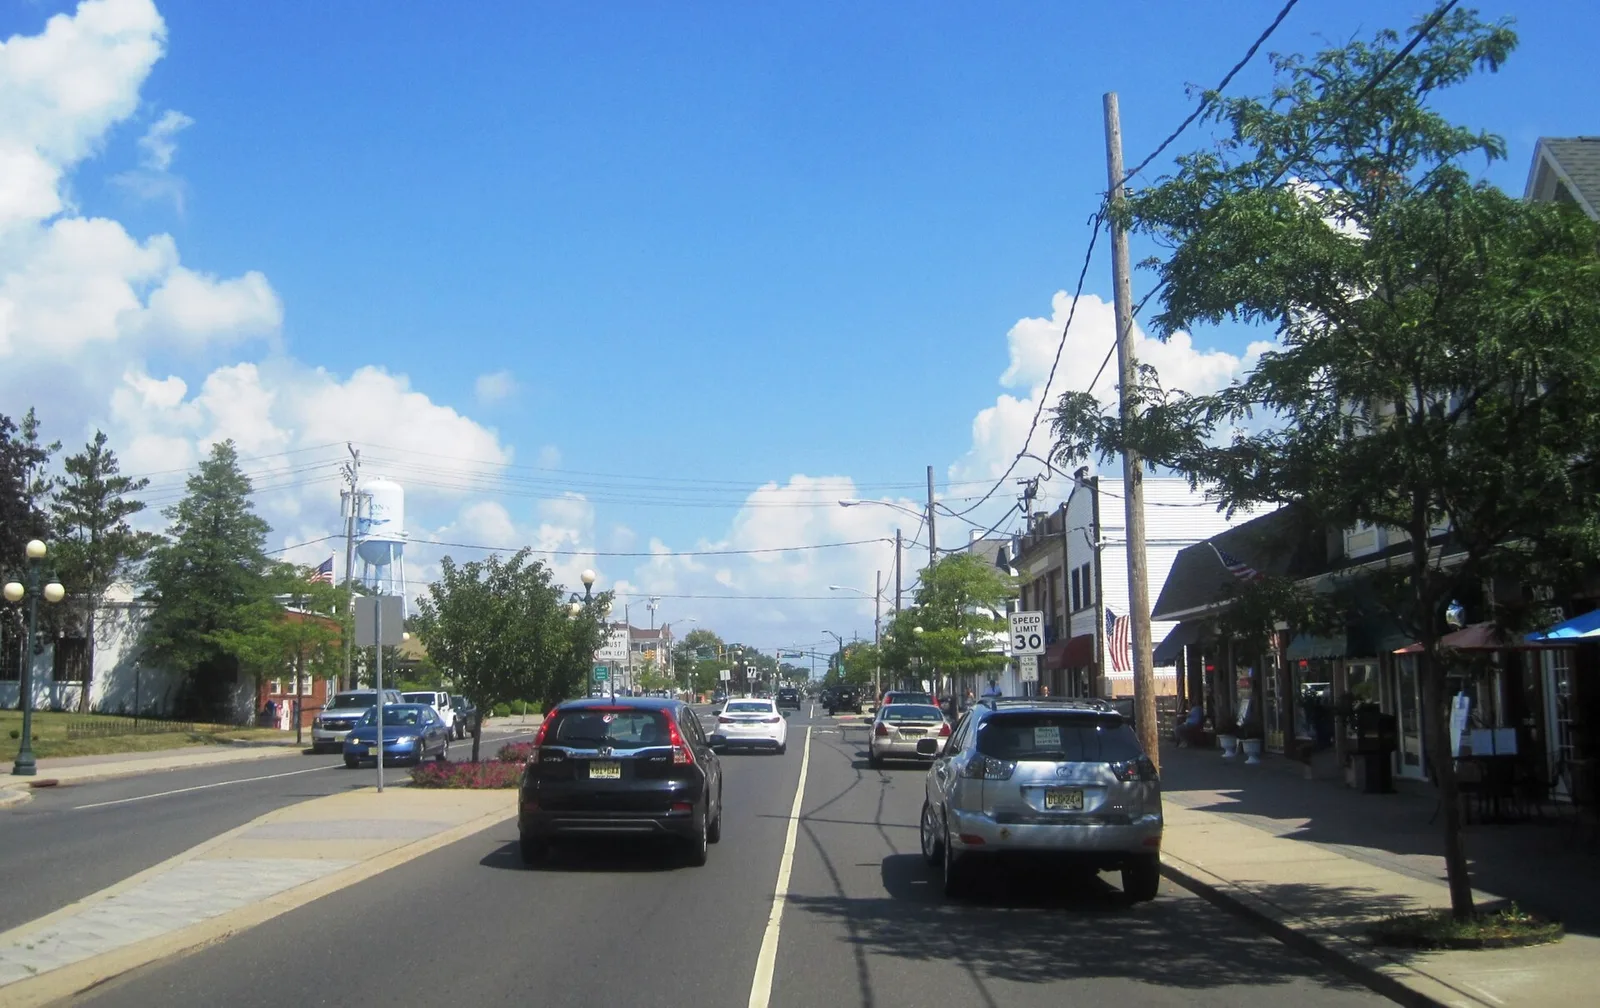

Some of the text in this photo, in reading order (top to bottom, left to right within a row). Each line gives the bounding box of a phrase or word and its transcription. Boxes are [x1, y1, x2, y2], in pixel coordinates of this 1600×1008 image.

[1012, 616, 1040, 625] SPEED
[1015, 625, 1038, 633] LIMIT
[1014, 633, 1042, 650] 30
